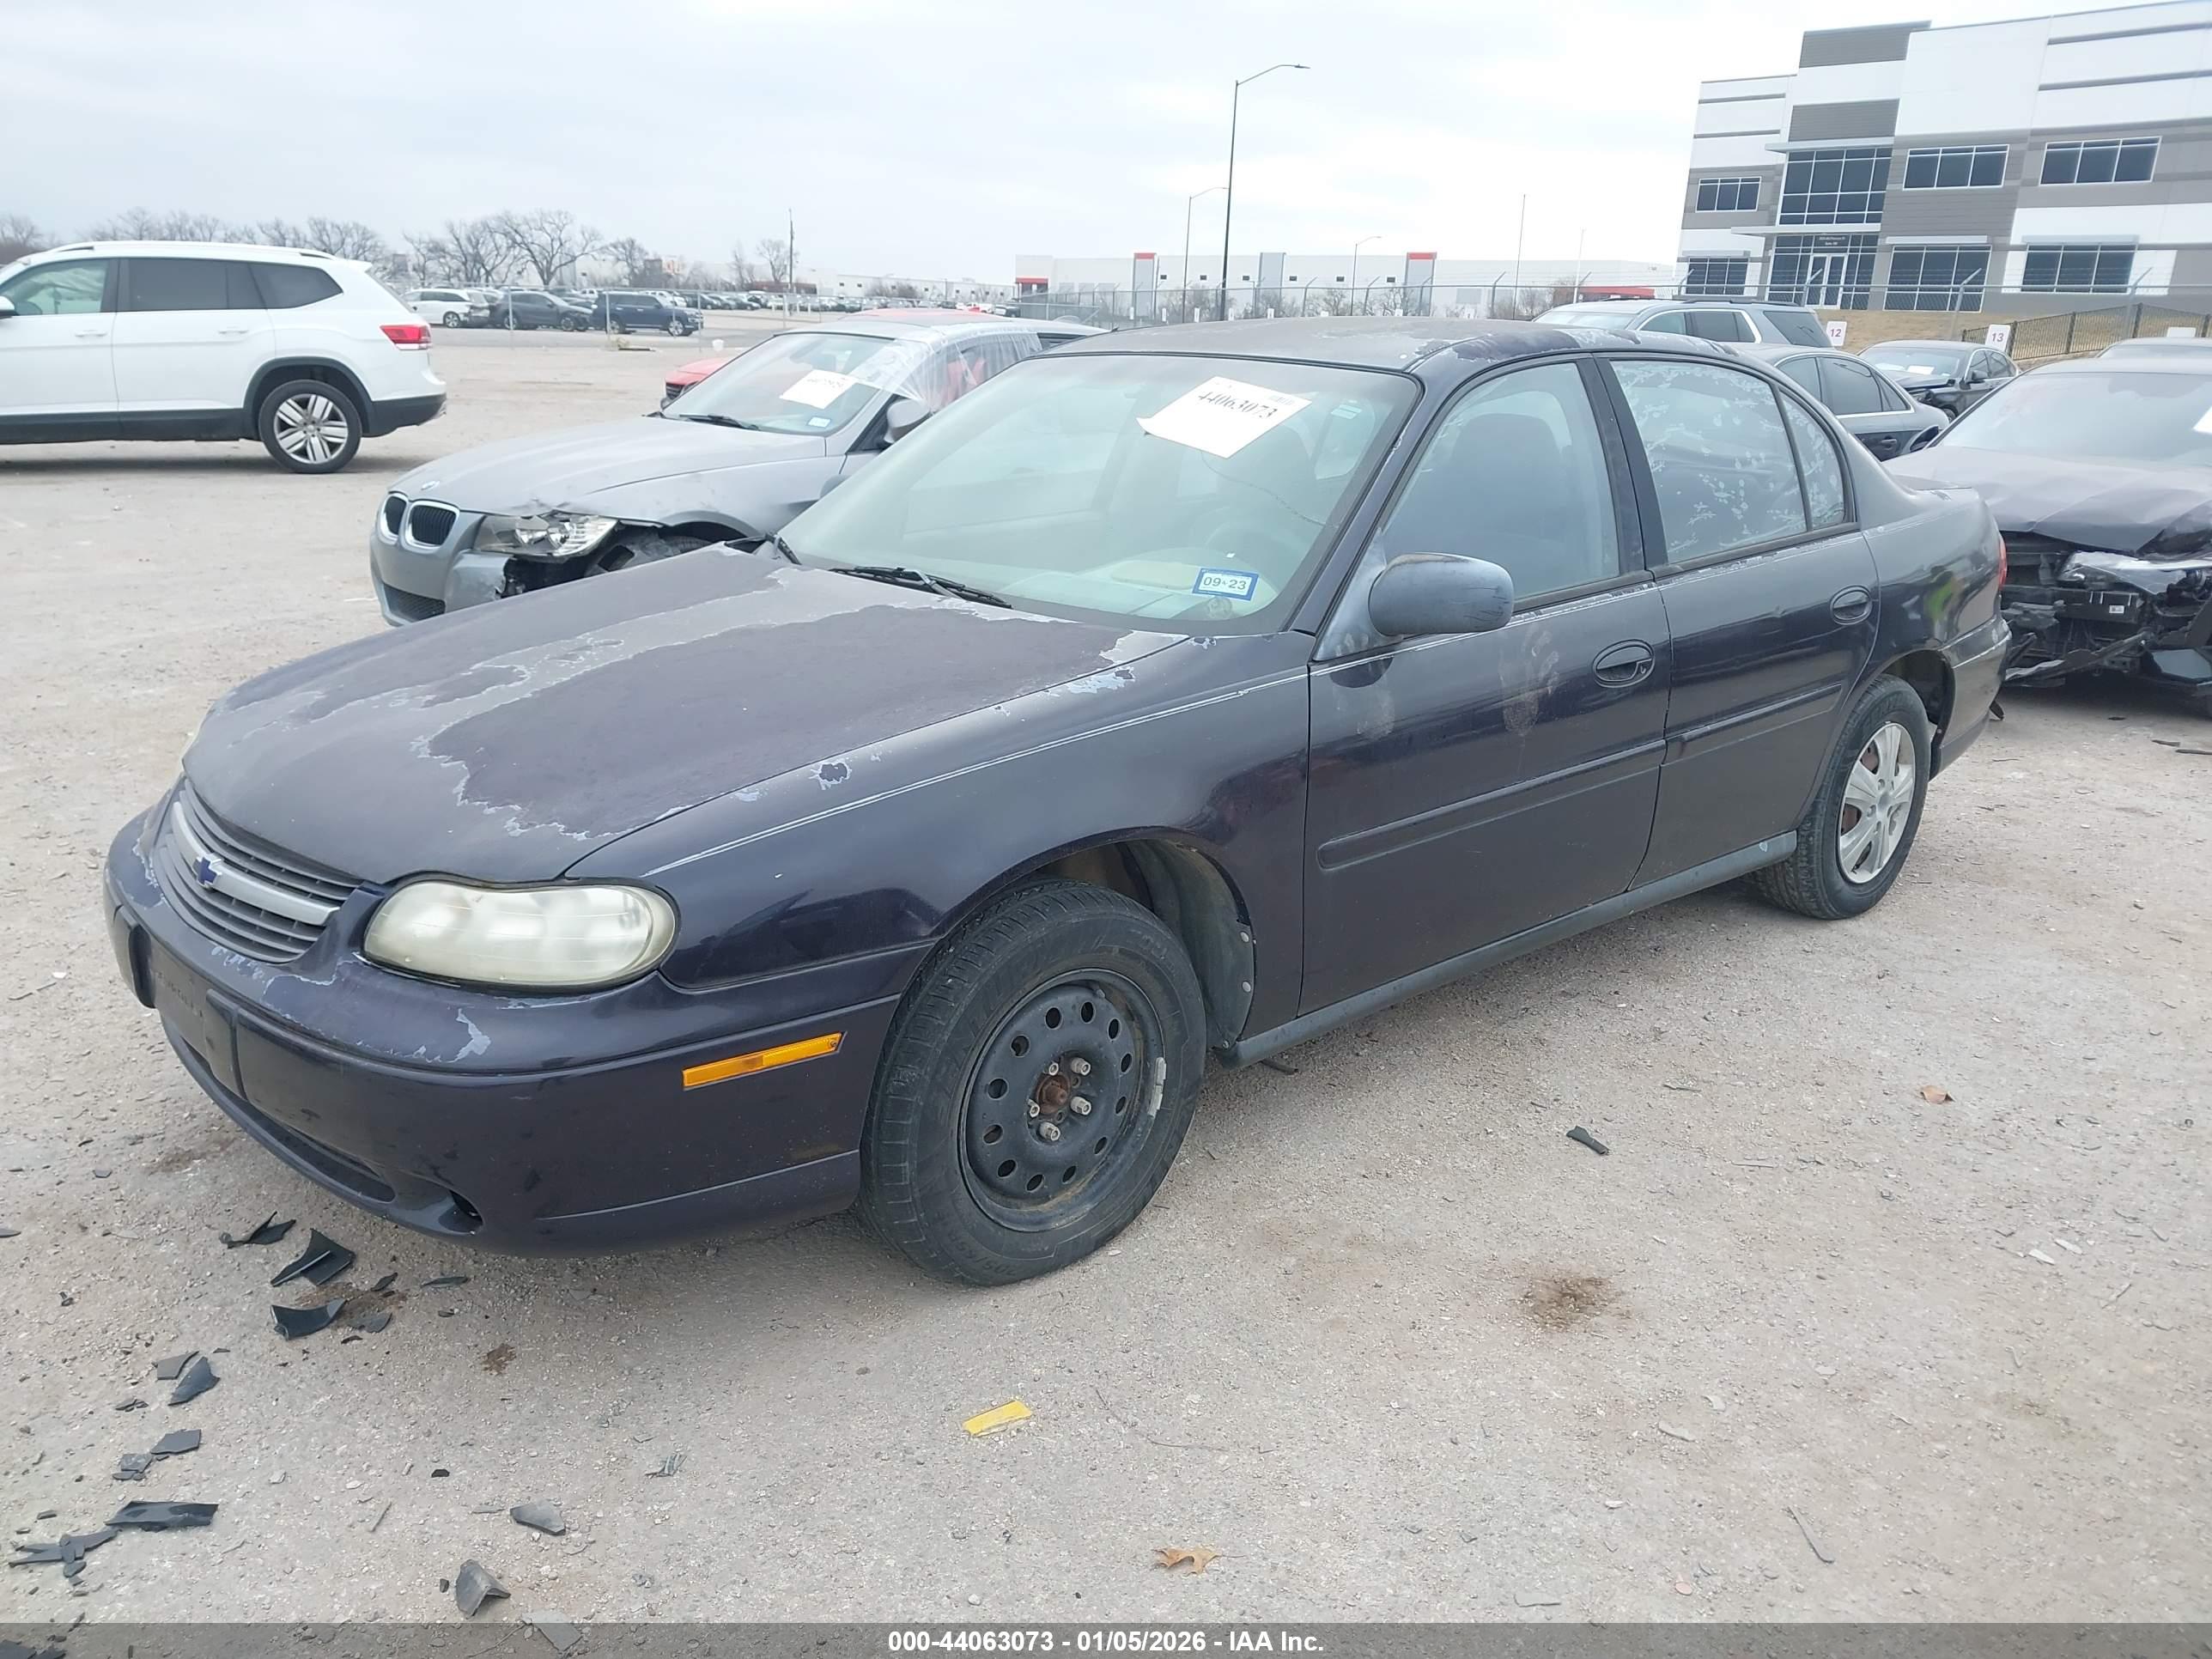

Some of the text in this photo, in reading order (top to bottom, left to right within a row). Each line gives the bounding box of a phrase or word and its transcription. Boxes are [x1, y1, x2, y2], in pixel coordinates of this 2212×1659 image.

[1830, 328, 1842, 337] 12
[1991, 332, 2004, 343] 13
[1198, 392, 1278, 419] 44063073
